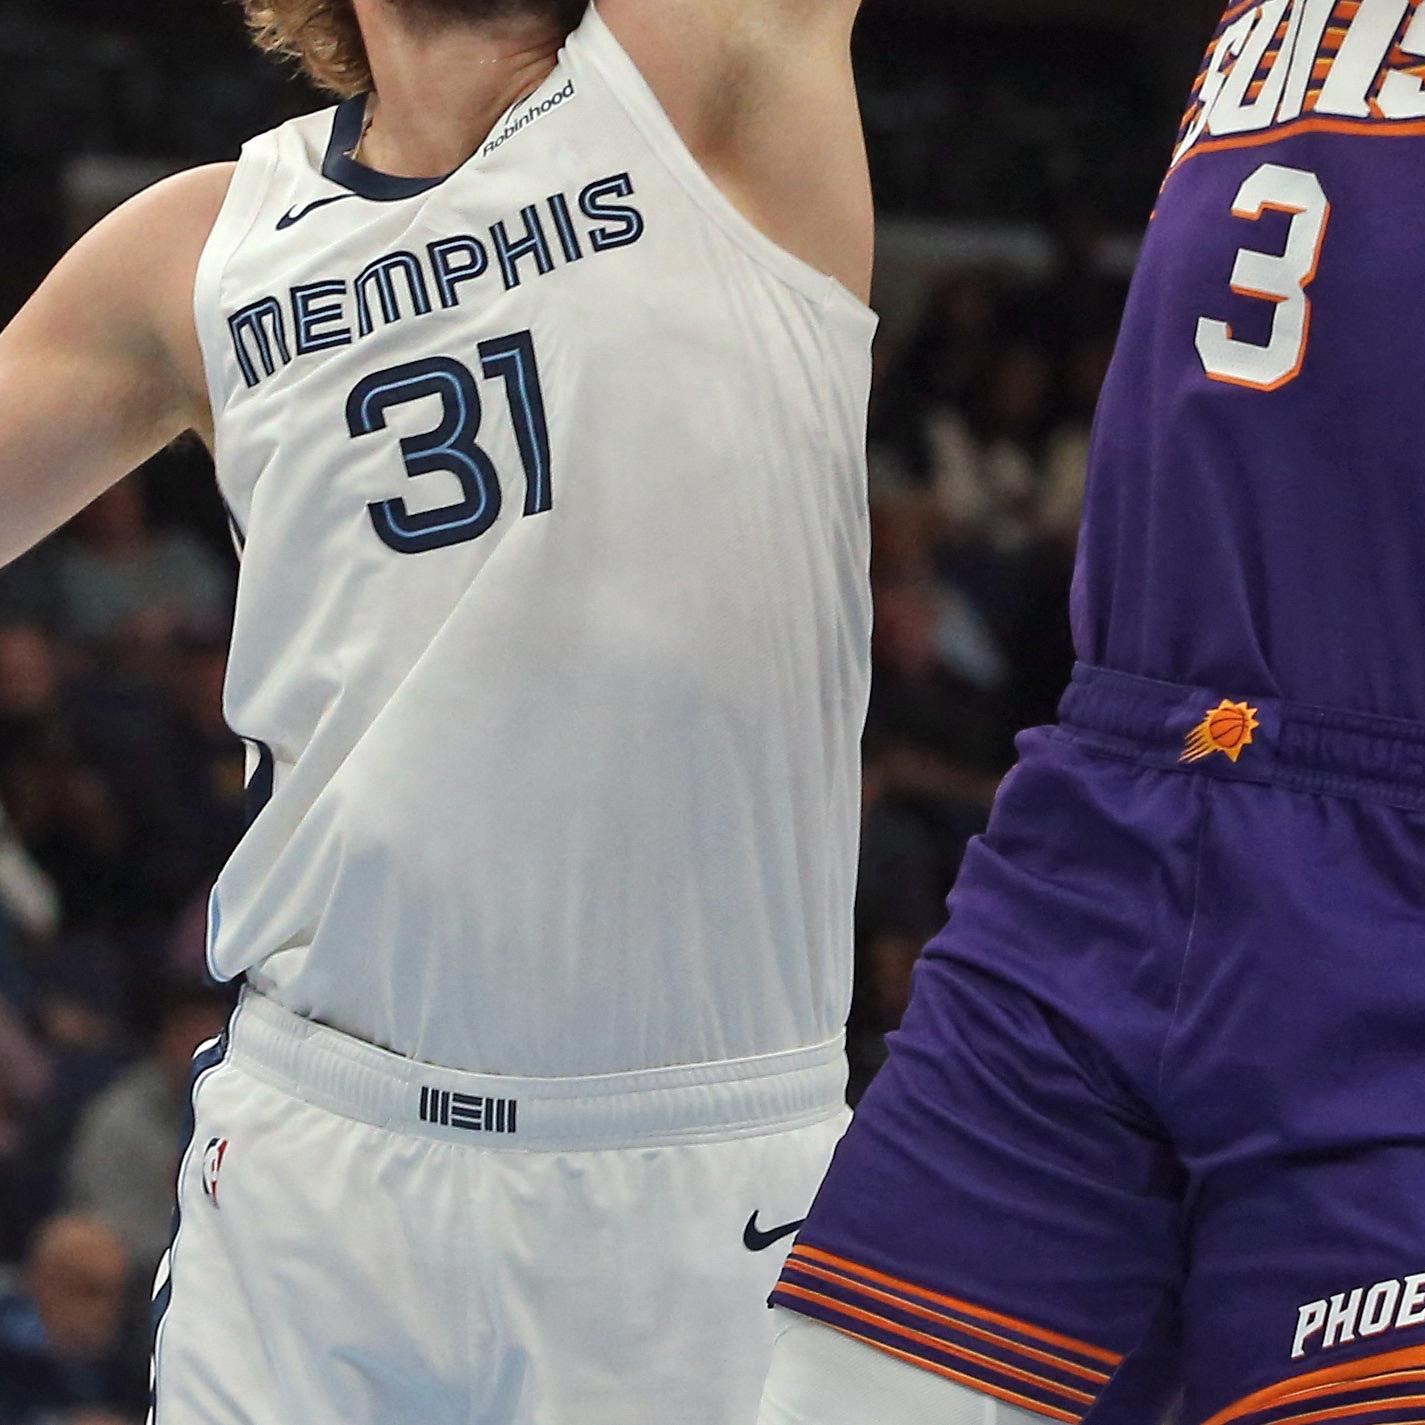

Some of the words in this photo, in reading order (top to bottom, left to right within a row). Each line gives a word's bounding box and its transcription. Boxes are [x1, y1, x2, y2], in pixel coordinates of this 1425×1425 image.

[482, 78, 575, 158] Robinhood
[226, 172, 646, 388] MEMPHIS
[1194, 163, 1332, 392] 3
[345, 329, 553, 556] 31
